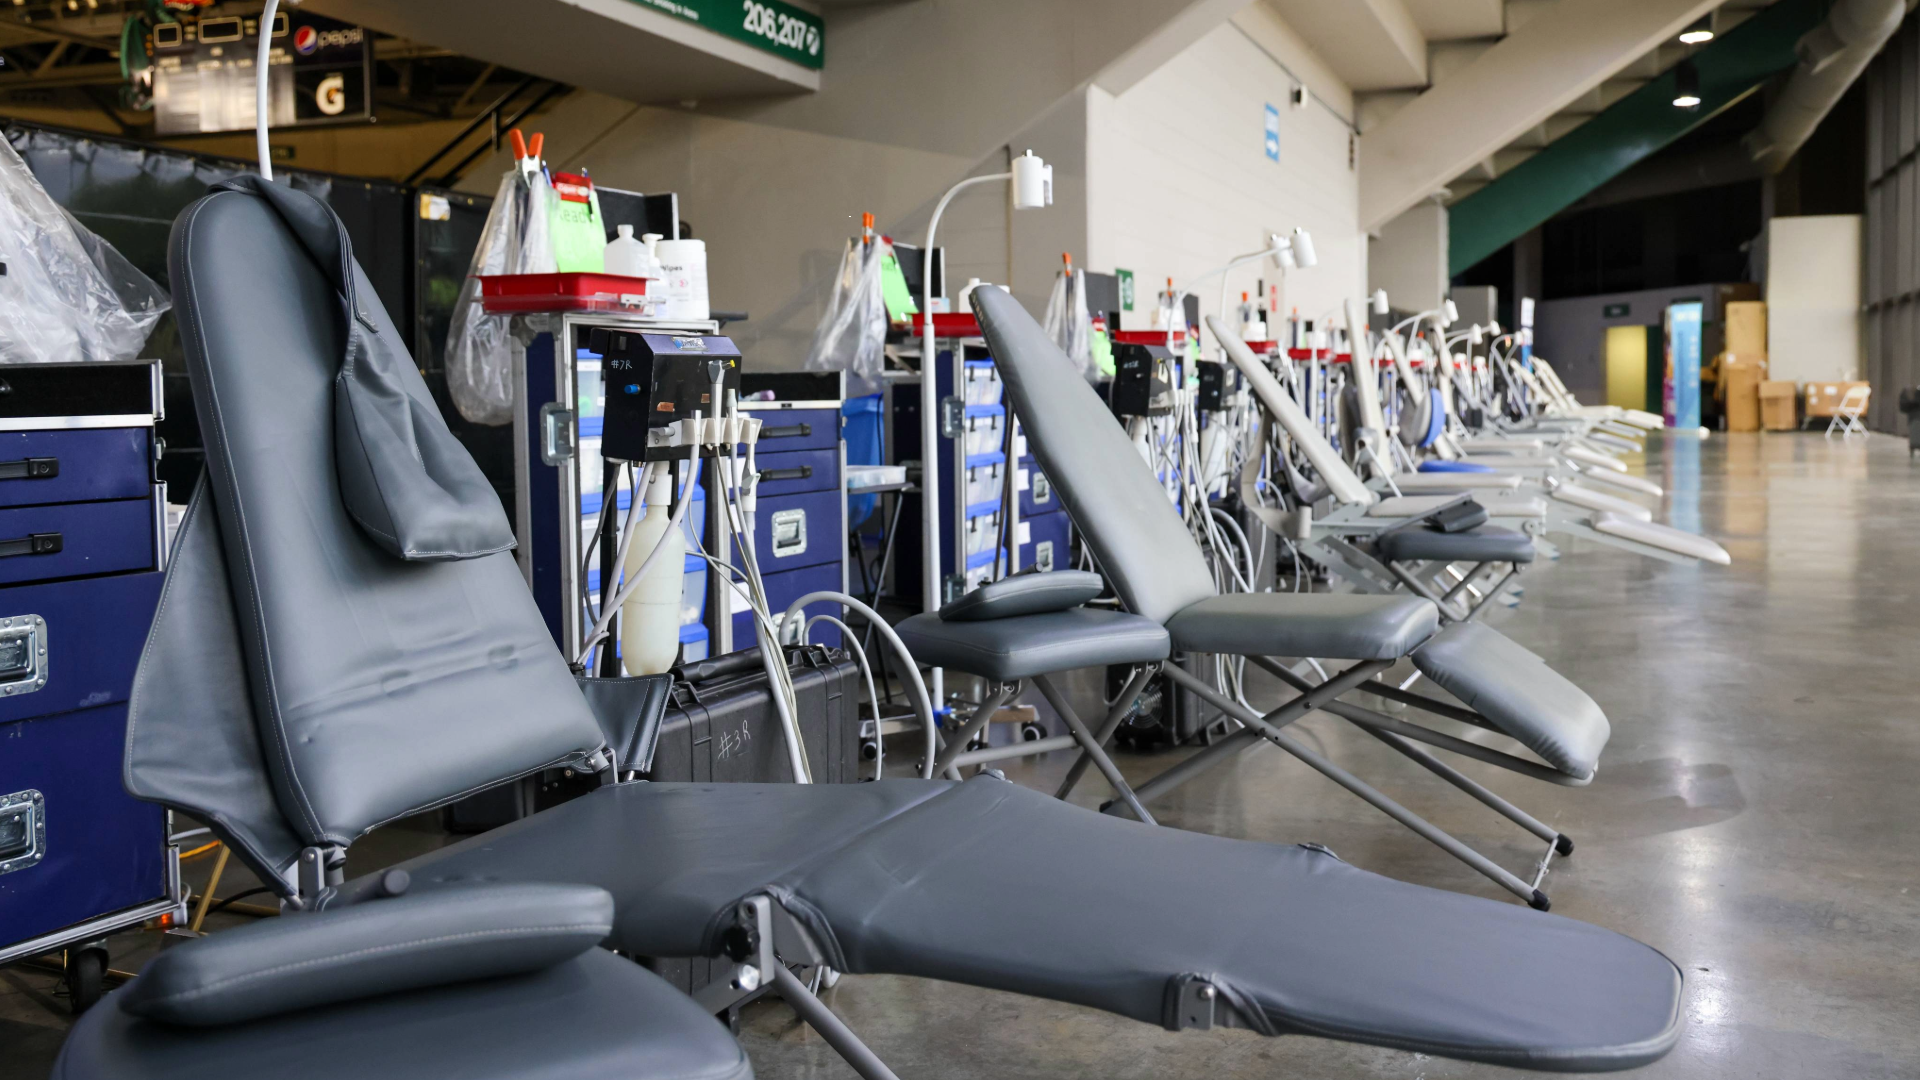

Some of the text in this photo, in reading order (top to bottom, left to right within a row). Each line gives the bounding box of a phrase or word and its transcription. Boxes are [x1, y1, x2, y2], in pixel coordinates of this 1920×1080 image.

[317, 27, 363, 47] pepsi
[743, 1, 807, 50] 206,207
[316, 74, 345, 115] G
[718, 719, 751, 760] #3R
